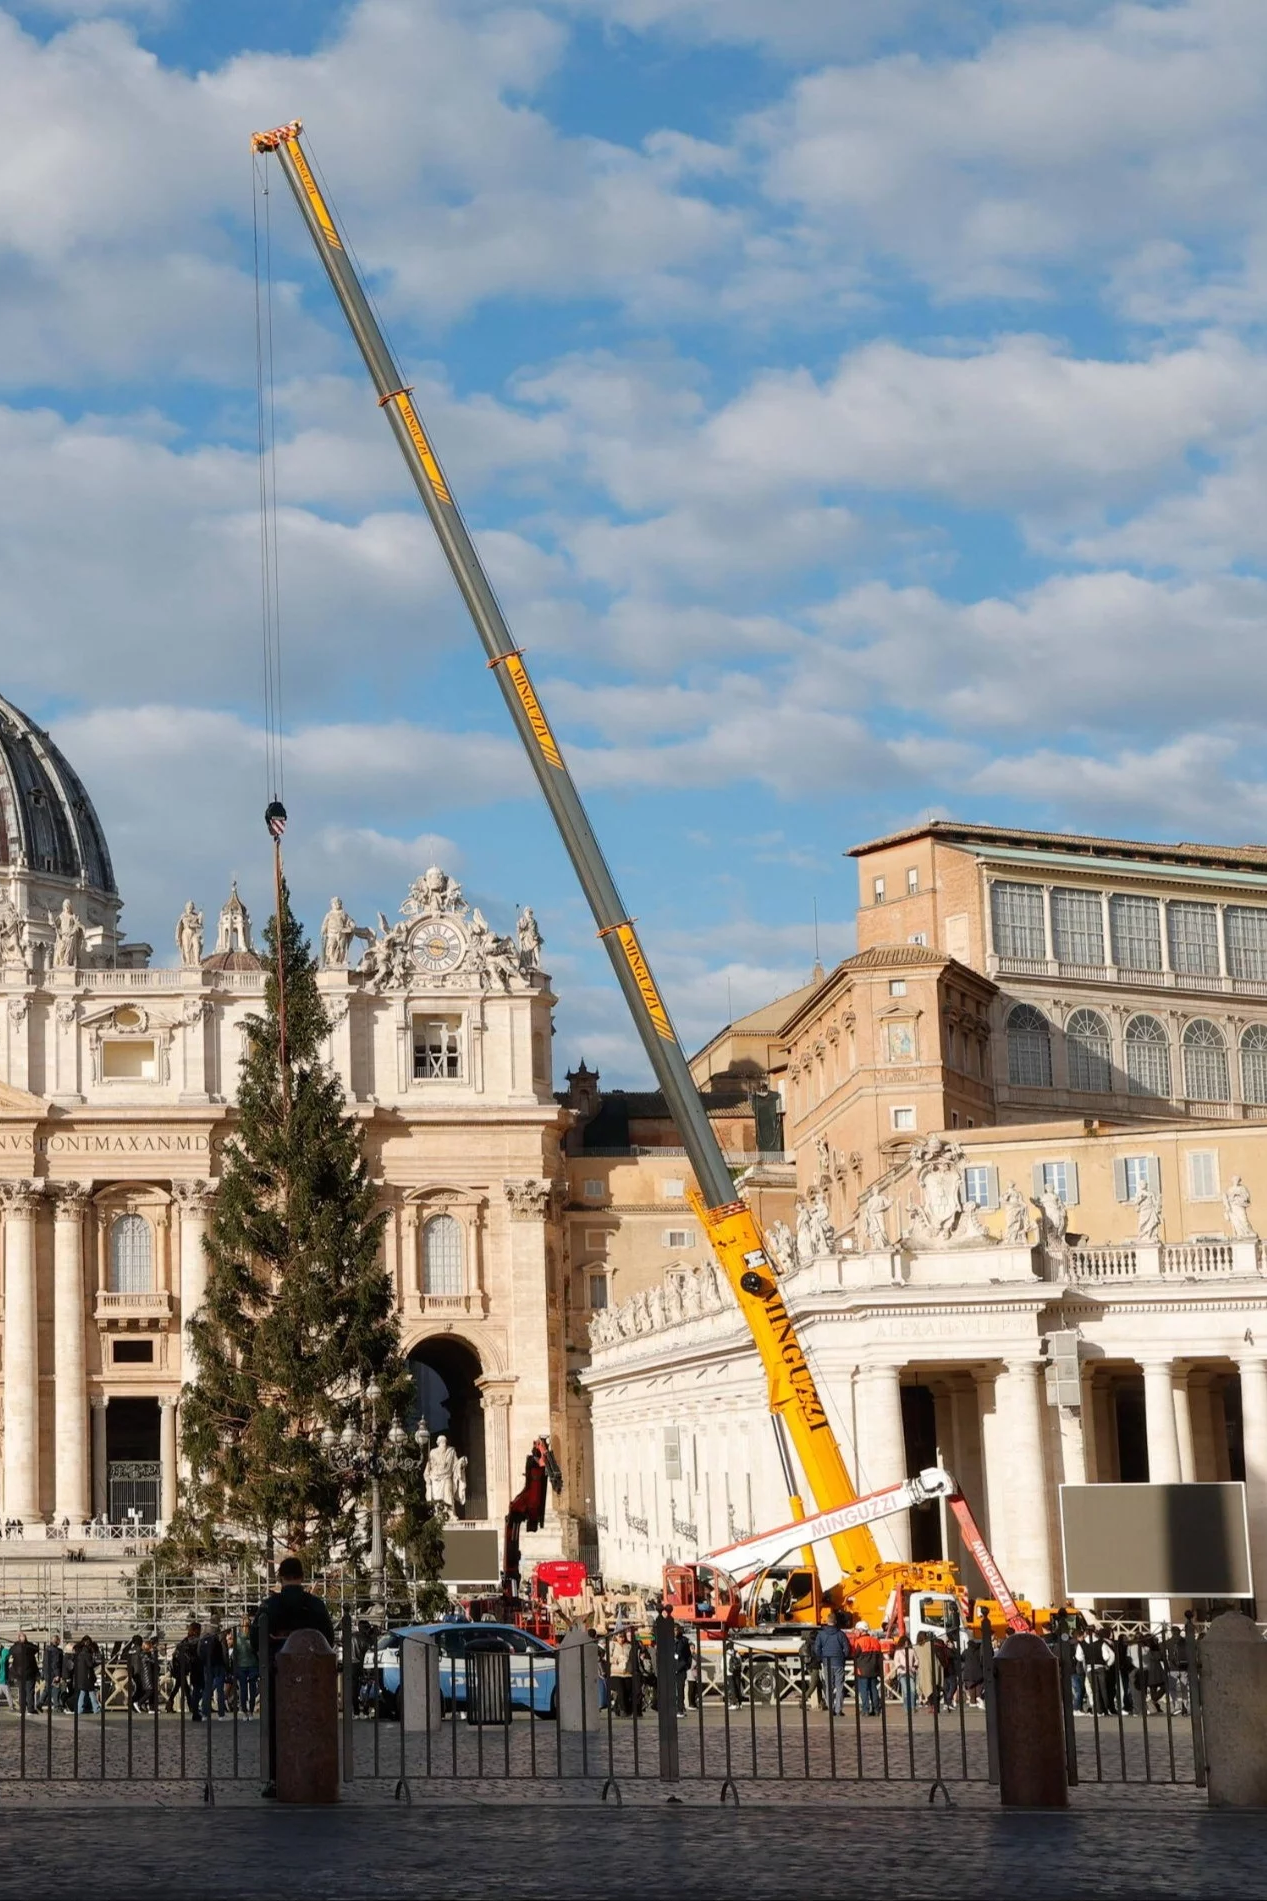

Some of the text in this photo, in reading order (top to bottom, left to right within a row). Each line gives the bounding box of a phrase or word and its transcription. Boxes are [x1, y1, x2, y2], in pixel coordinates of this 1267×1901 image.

[294, 151, 316, 195] MINGUZZI
[402, 405, 428, 456] MINGUZZI
[513, 668, 548, 737] MINGUZZI
[624, 938, 659, 1010] MINGUZZI
[39, 1136, 93, 1151] PONT
[95, 1135, 139, 1151] MAX
[140, 1135, 170, 1151] AN
[765, 1287, 829, 1433] MINGUZZI
[811, 1494, 898, 1539] MINGUZZI
[972, 1540, 1014, 1610] MINGUZZI
